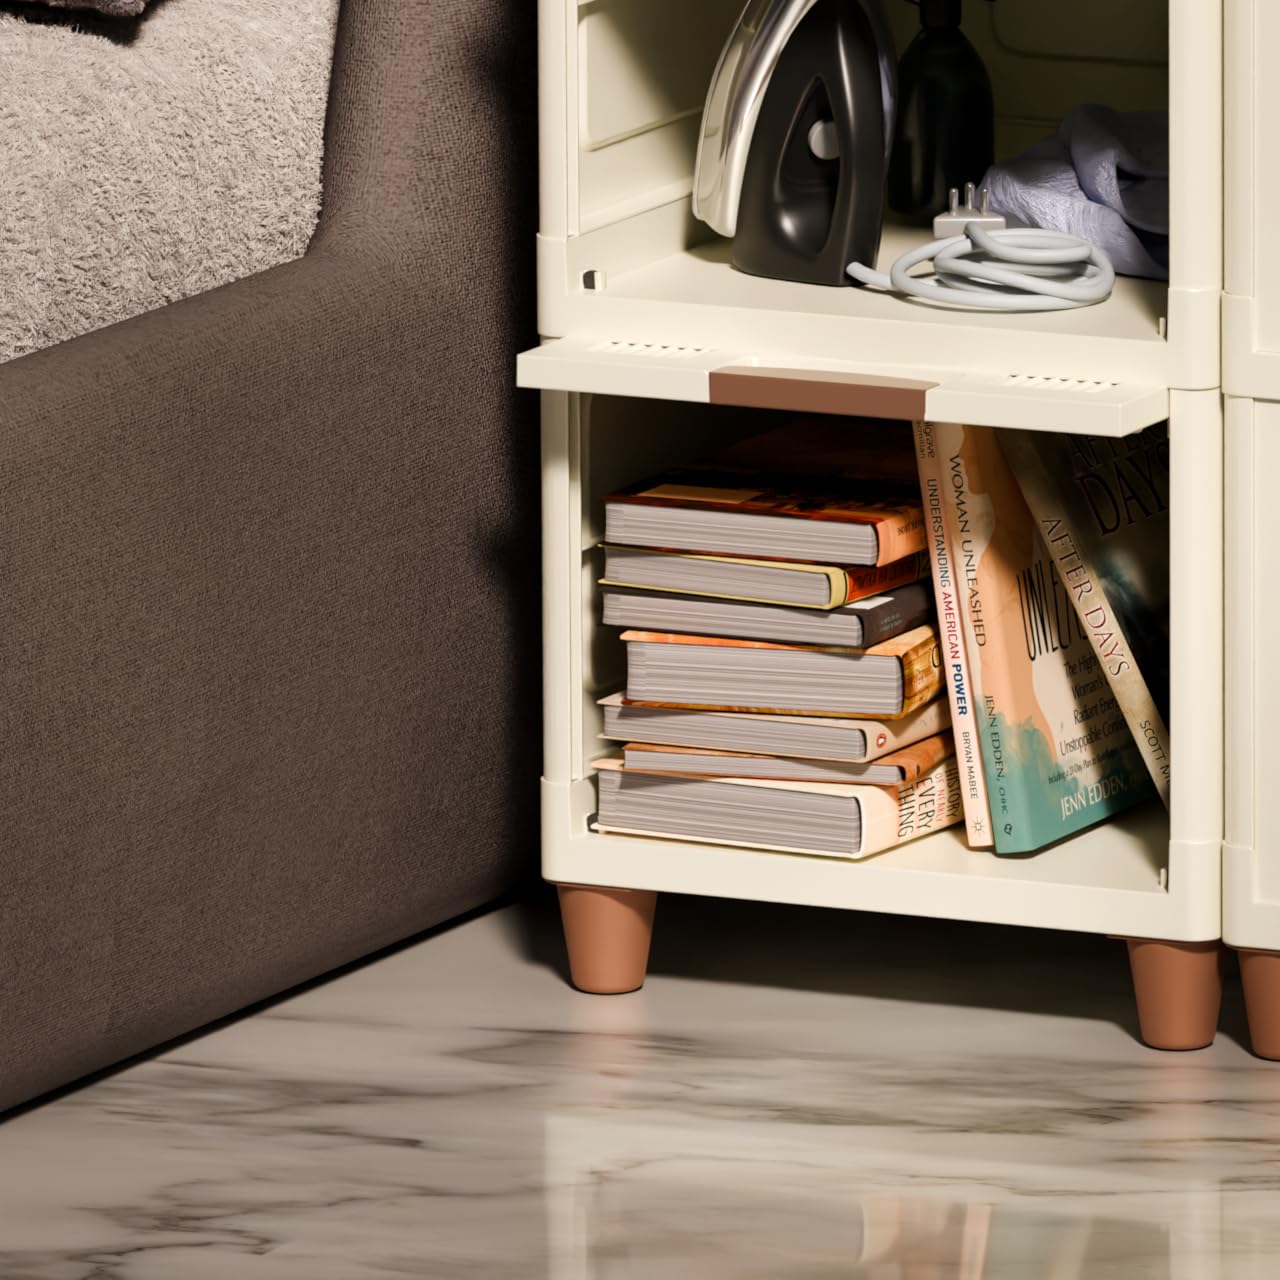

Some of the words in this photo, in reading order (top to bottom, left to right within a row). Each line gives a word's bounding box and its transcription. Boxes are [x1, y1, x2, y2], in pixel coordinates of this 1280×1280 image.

[949, 455, 970, 533] WOMAN
[961, 540, 986, 647] UNLEASHED
[927, 478, 951, 588] UNDERSTANDING
[942, 592, 960, 659] AMERICAN
[952, 664, 967, 715] POWER
[1042, 520, 1093, 602] AFTER
[1084, 606, 1129, 676] DAYS
[985, 695, 997, 727] JENN
[962, 731, 973, 763] BRYAN
[1059, 724, 1101, 757] Unstoppable
[1140, 720, 1166, 760] SCOTT
[916, 777, 935, 829] EVERY
[945, 767, 960, 817] HISTORY
[967, 765, 978, 799] MABEE
[897, 784, 915, 837] THING
[1060, 790, 1087, 821] JENN
